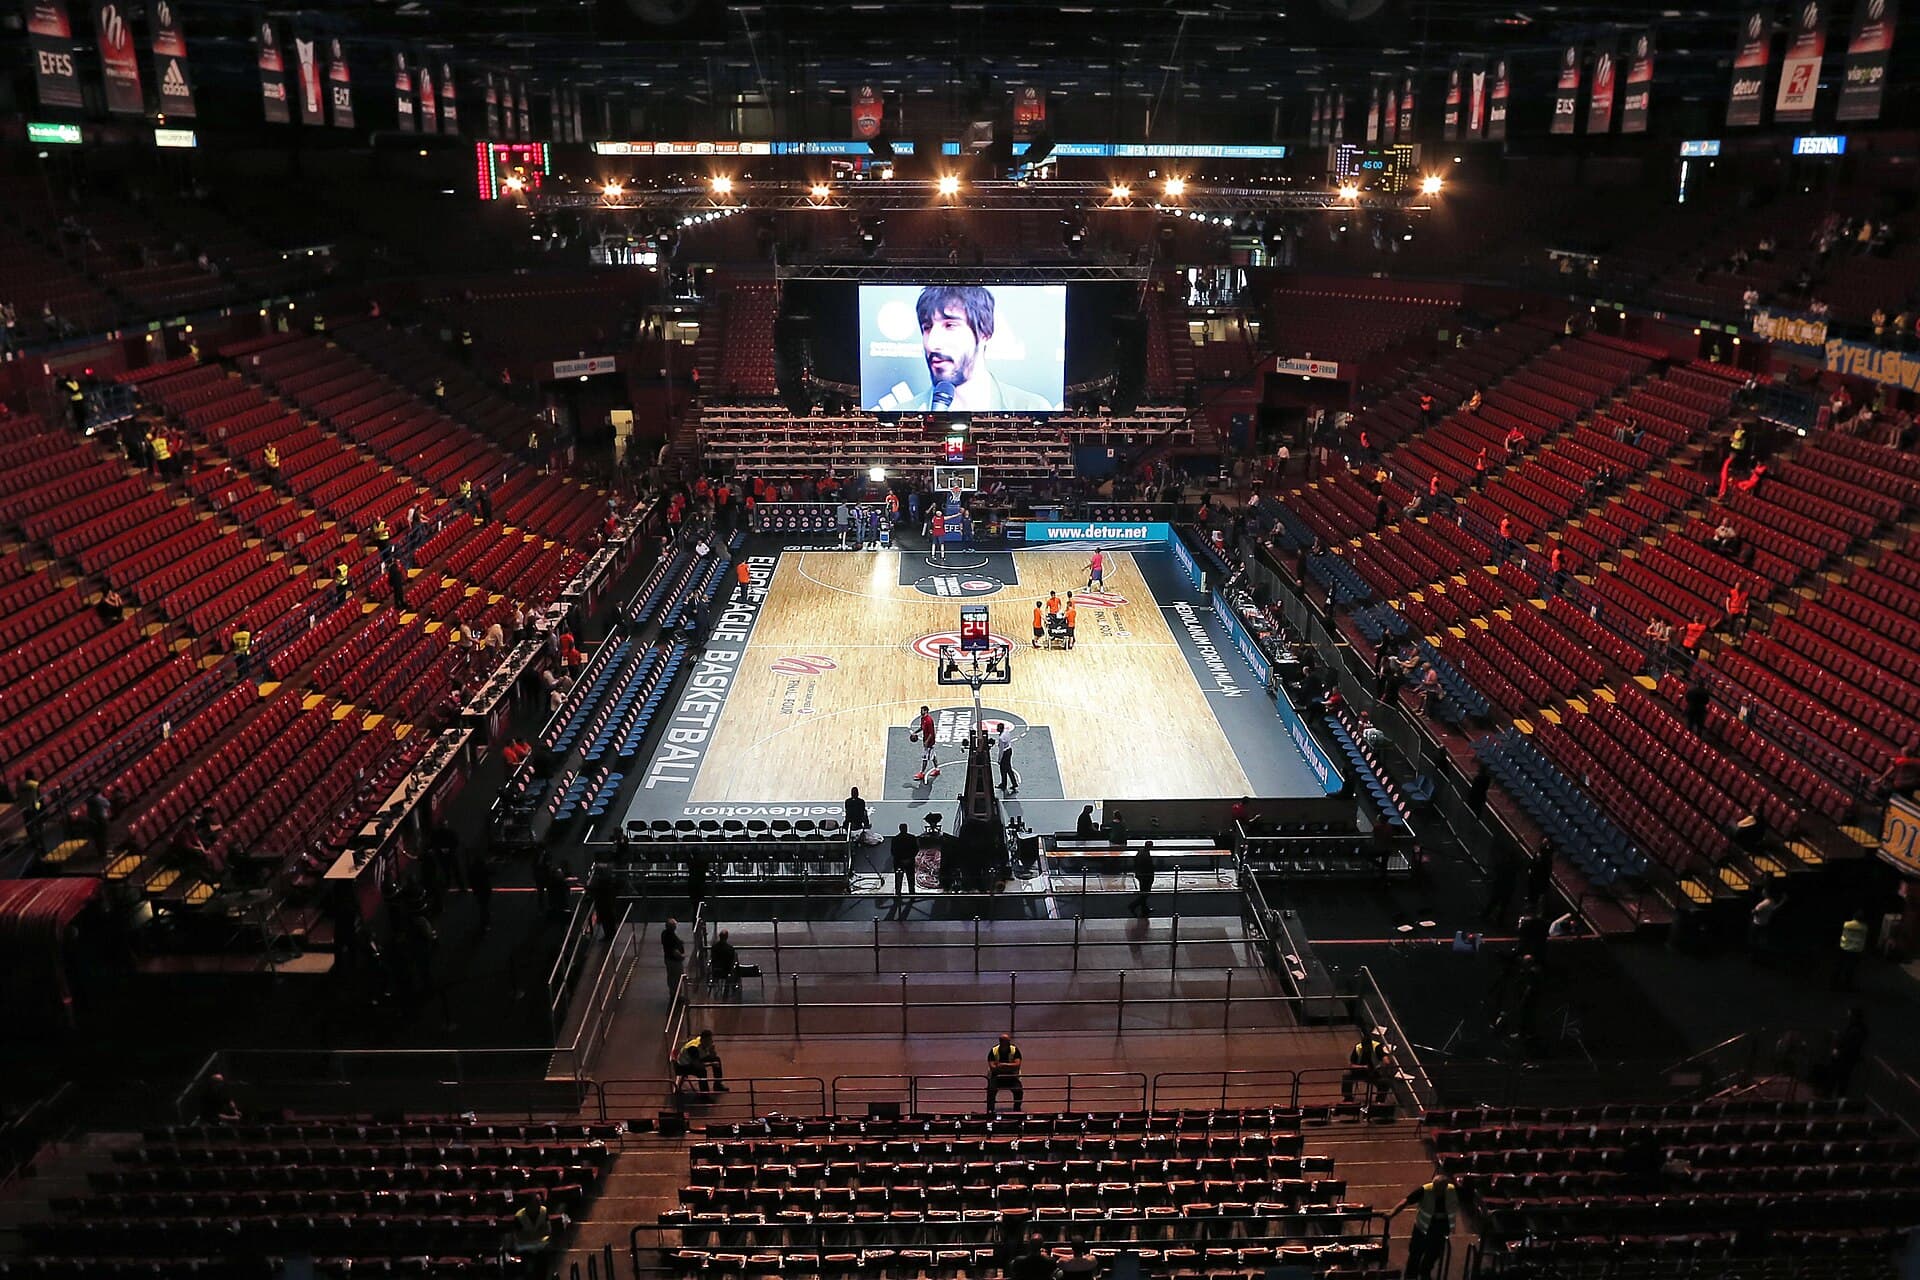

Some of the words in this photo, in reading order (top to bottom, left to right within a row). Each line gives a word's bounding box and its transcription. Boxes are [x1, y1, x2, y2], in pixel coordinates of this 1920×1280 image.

[39, 51, 73, 77] EFES
[1847, 65, 1884, 84] viagogo
[163, 83, 190, 97] adidas
[1732, 78, 1762, 96] detur
[1798, 137, 1840, 154] FESTINA
[945, 525, 962, 533] EFE
[1048, 524, 1148, 540] www.detur.net
[963, 621, 987, 636] 24
[1172, 601, 1213, 645] MEDIOLANUM
[1197, 645, 1229, 672] FORUM
[1210, 671, 1244, 697] MILAN
[645, 648, 740, 790] BASKETBALL
[953, 710, 971, 743] TURKISH
